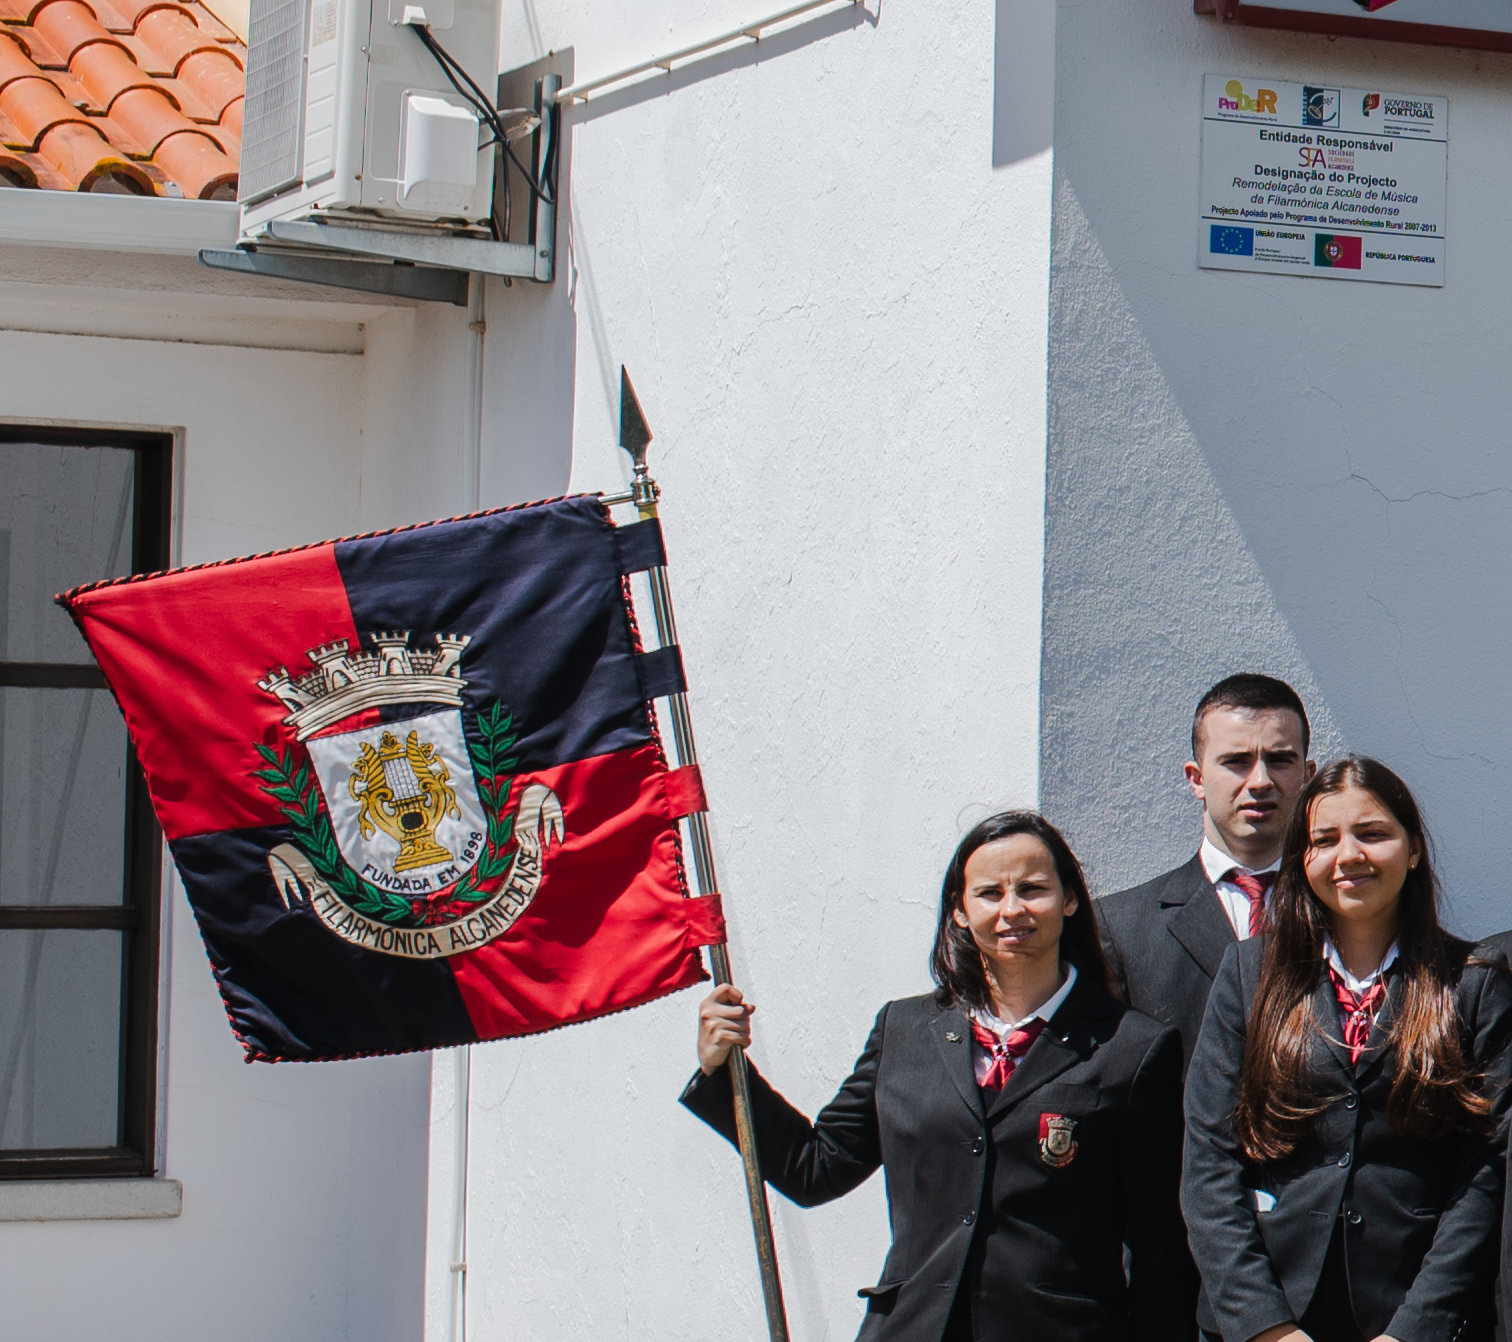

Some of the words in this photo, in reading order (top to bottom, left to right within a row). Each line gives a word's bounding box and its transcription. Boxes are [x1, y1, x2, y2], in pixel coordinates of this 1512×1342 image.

[1384, 98, 1422, 109] GOVERNO
[1423, 102, 1434, 110] DE
[1384, 106, 1435, 119] PORTUGAL
[1259, 129, 1313, 145] Entidade
[1316, 134, 1394, 153] Responsável
[1254, 164, 1326, 182] Designação
[1328, 171, 1345, 183] do
[1347, 172, 1398, 188] Projecto
[1232, 177, 1307, 195] Remodelação
[1309, 184, 1323, 195] da
[1326, 185, 1362, 199] Escola
[1364, 189, 1379, 201] de
[1381, 189, 1418, 204] Música
[1250, 193, 1265, 204] da
[1267, 194, 1330, 210] Filarmónica
[1331, 200, 1400, 216] Alcanedense
[1211, 205, 1240, 217] Projecto
[1240, 207, 1268, 219] Apoiado
[1385, 220, 1404, 230] Rural
[360, 862, 433, 892] FUNDADA
[436, 865, 461, 885] EM
[459, 830, 484, 864] 1898
[451, 846, 540, 951] ALCANEDENSE
